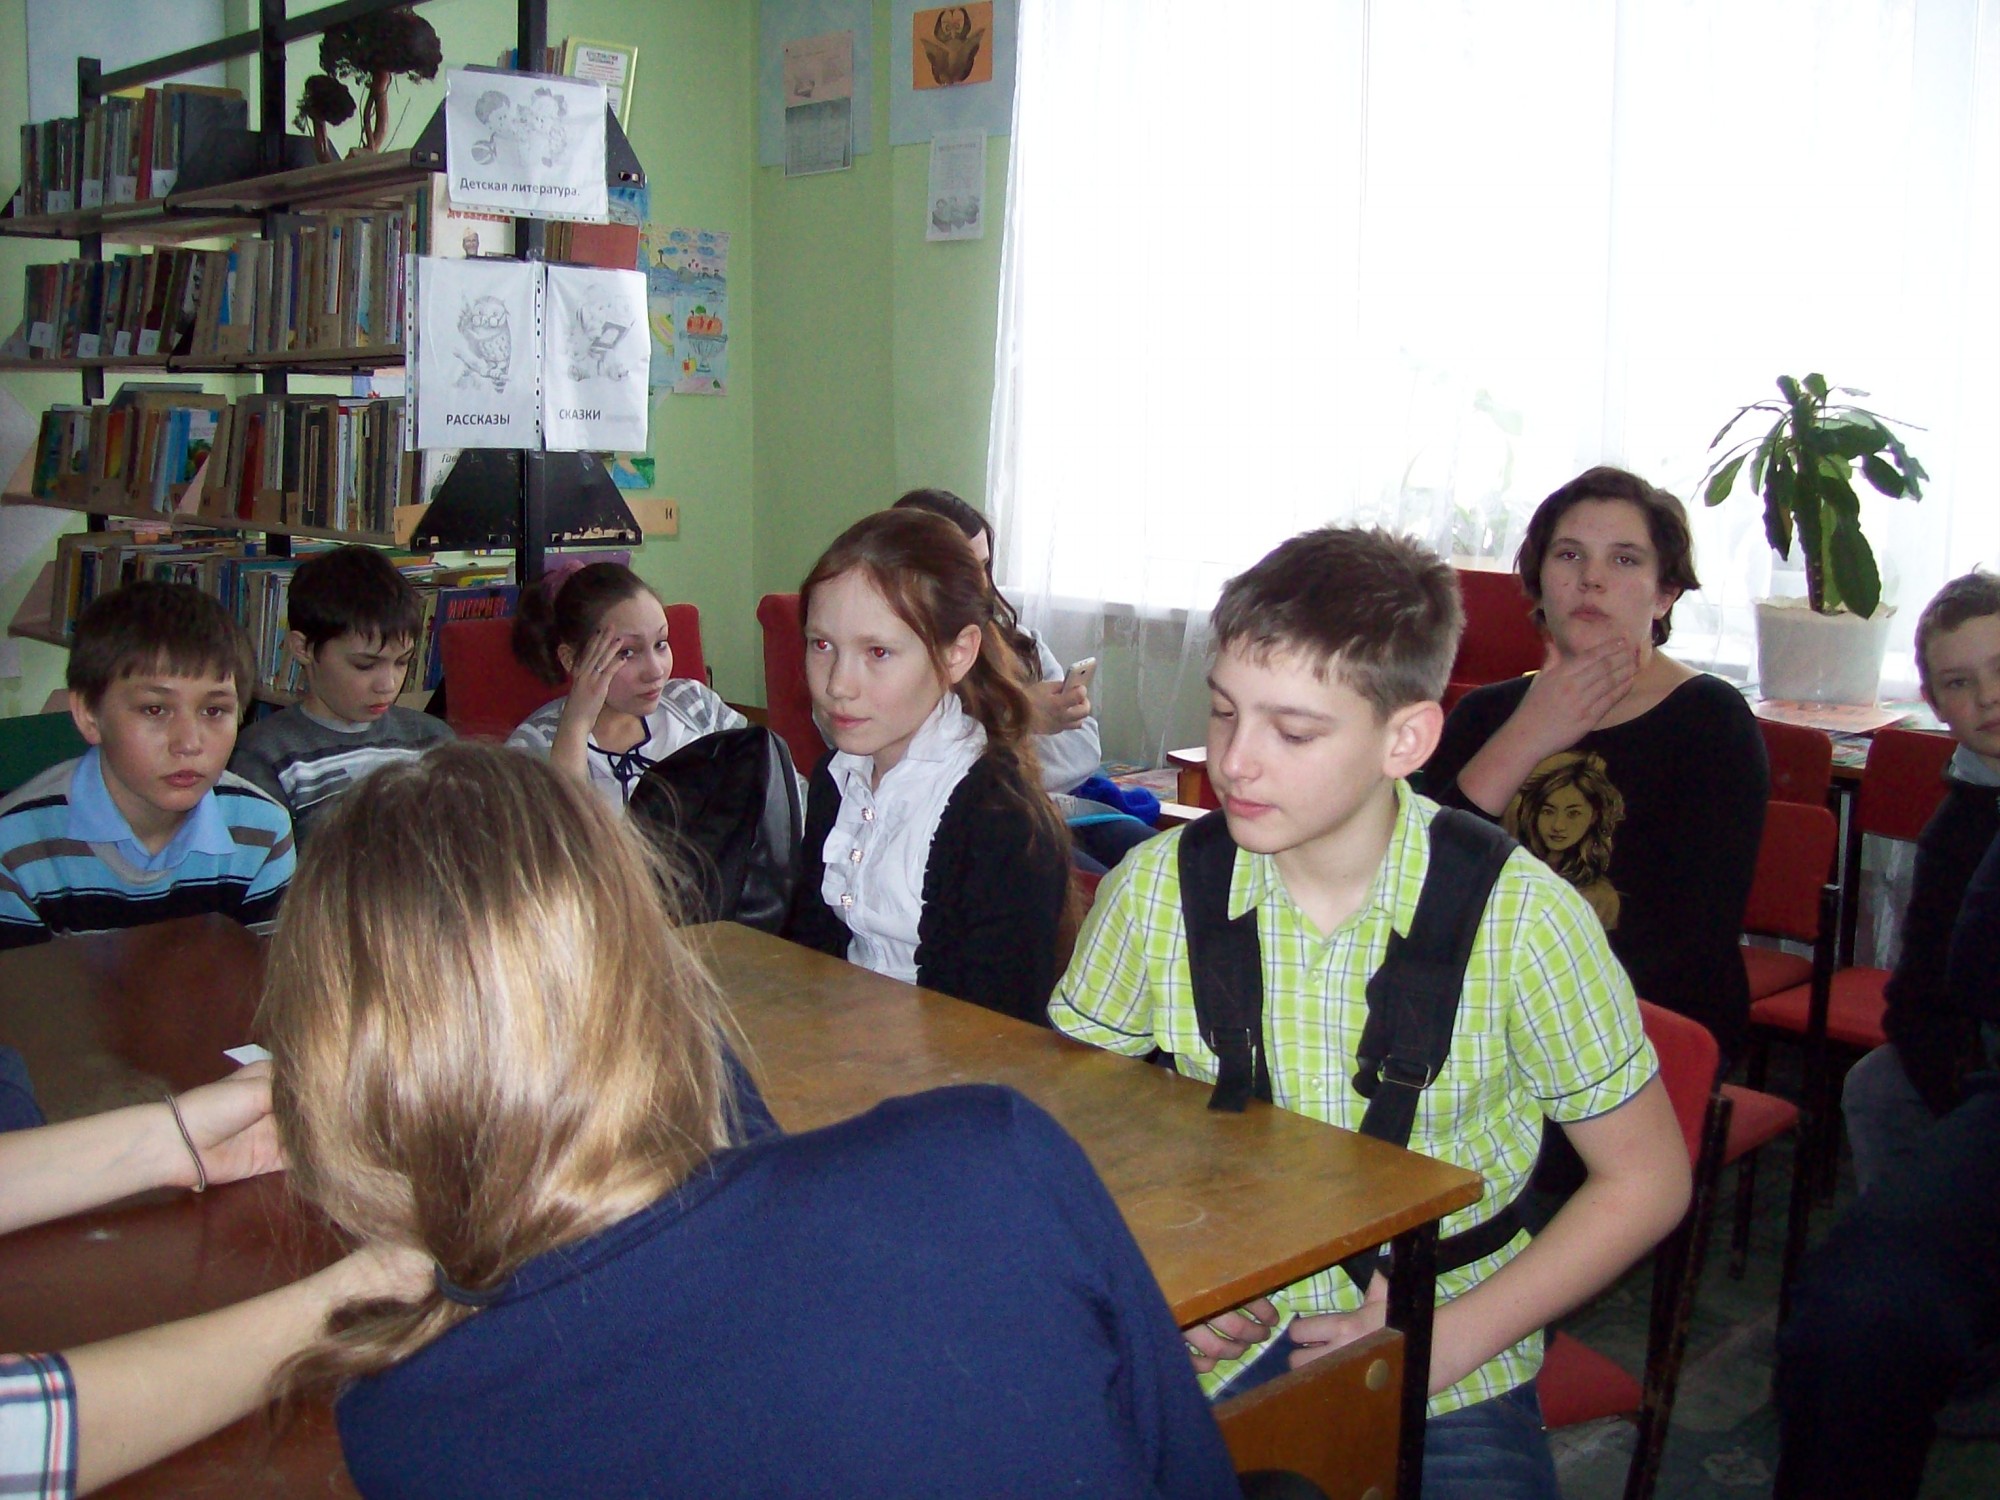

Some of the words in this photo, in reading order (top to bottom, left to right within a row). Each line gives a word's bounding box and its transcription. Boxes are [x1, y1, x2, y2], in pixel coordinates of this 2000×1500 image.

[459, 177, 508, 192] Детская
[511, 183, 580, 198] литература.
[446, 414, 511, 425] РАССКАЗЫ
[558, 408, 601, 420] СКАЗКИ
